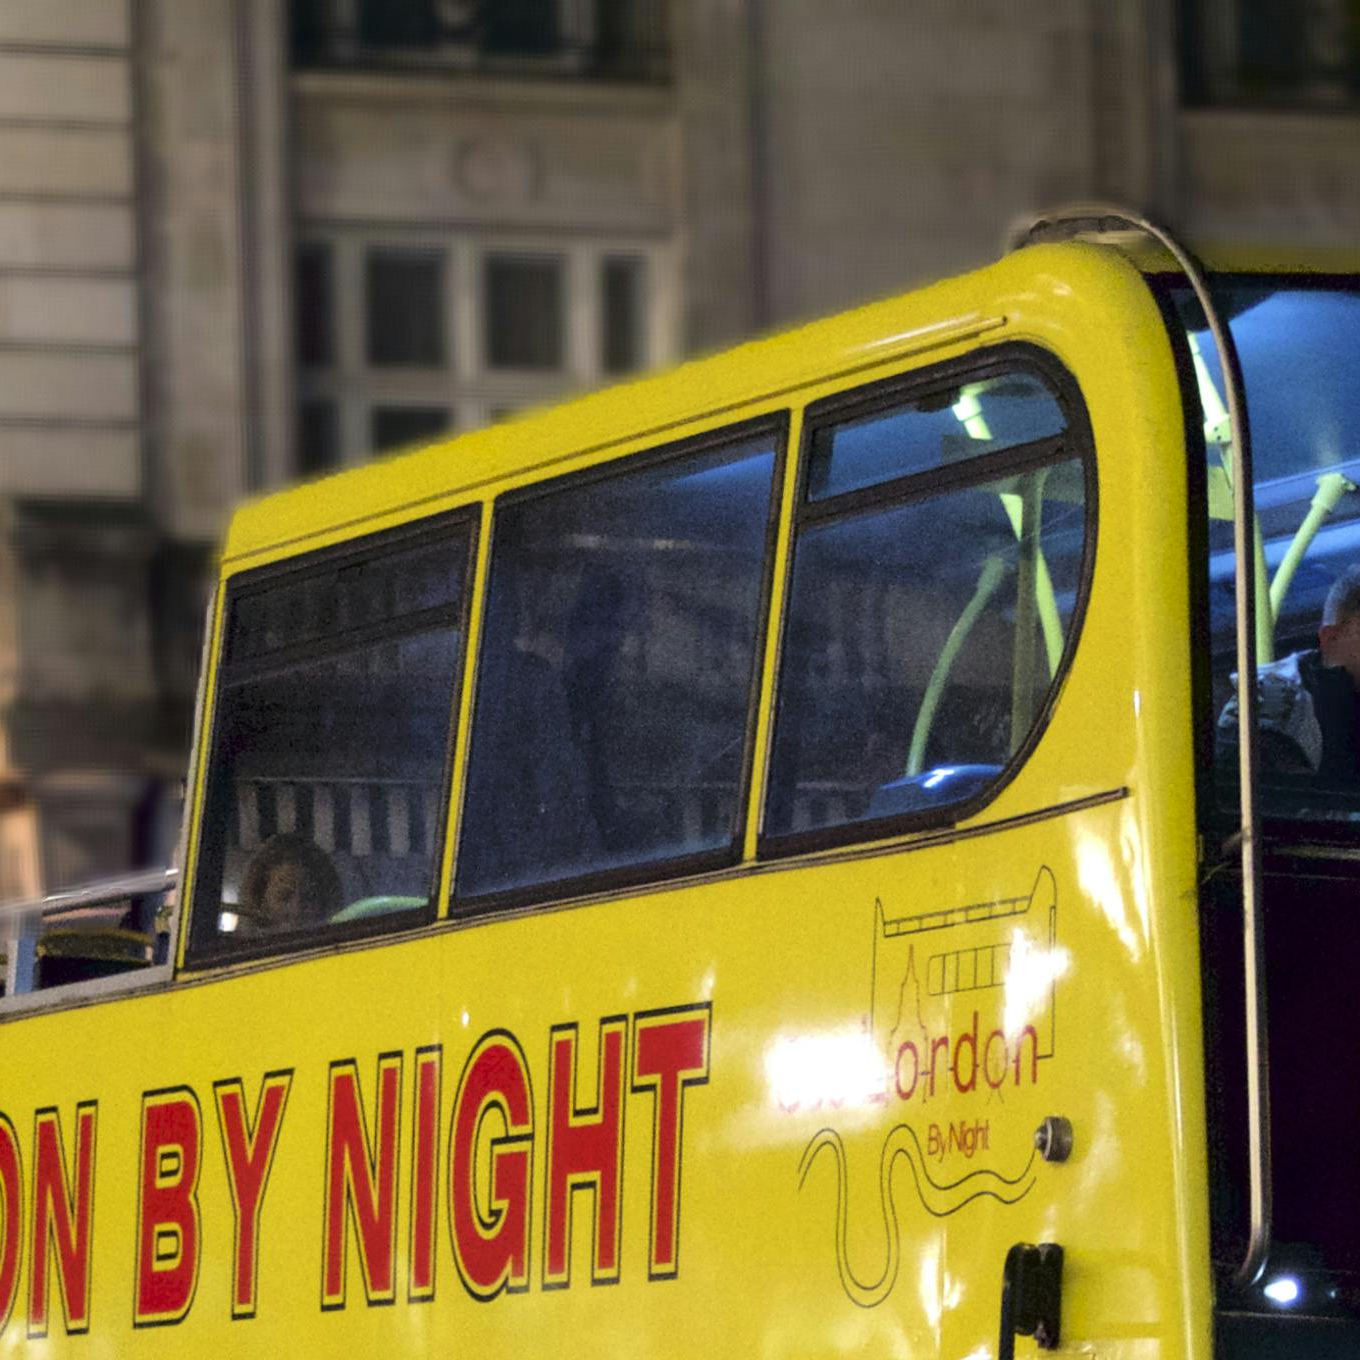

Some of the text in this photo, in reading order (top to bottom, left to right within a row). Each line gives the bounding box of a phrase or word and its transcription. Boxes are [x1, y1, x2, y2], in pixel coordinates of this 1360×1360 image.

[133, 1067, 295, 1329] BY
[320, 1000, 713, 1312] NIGHT
[948, 1118, 990, 1159] Night
